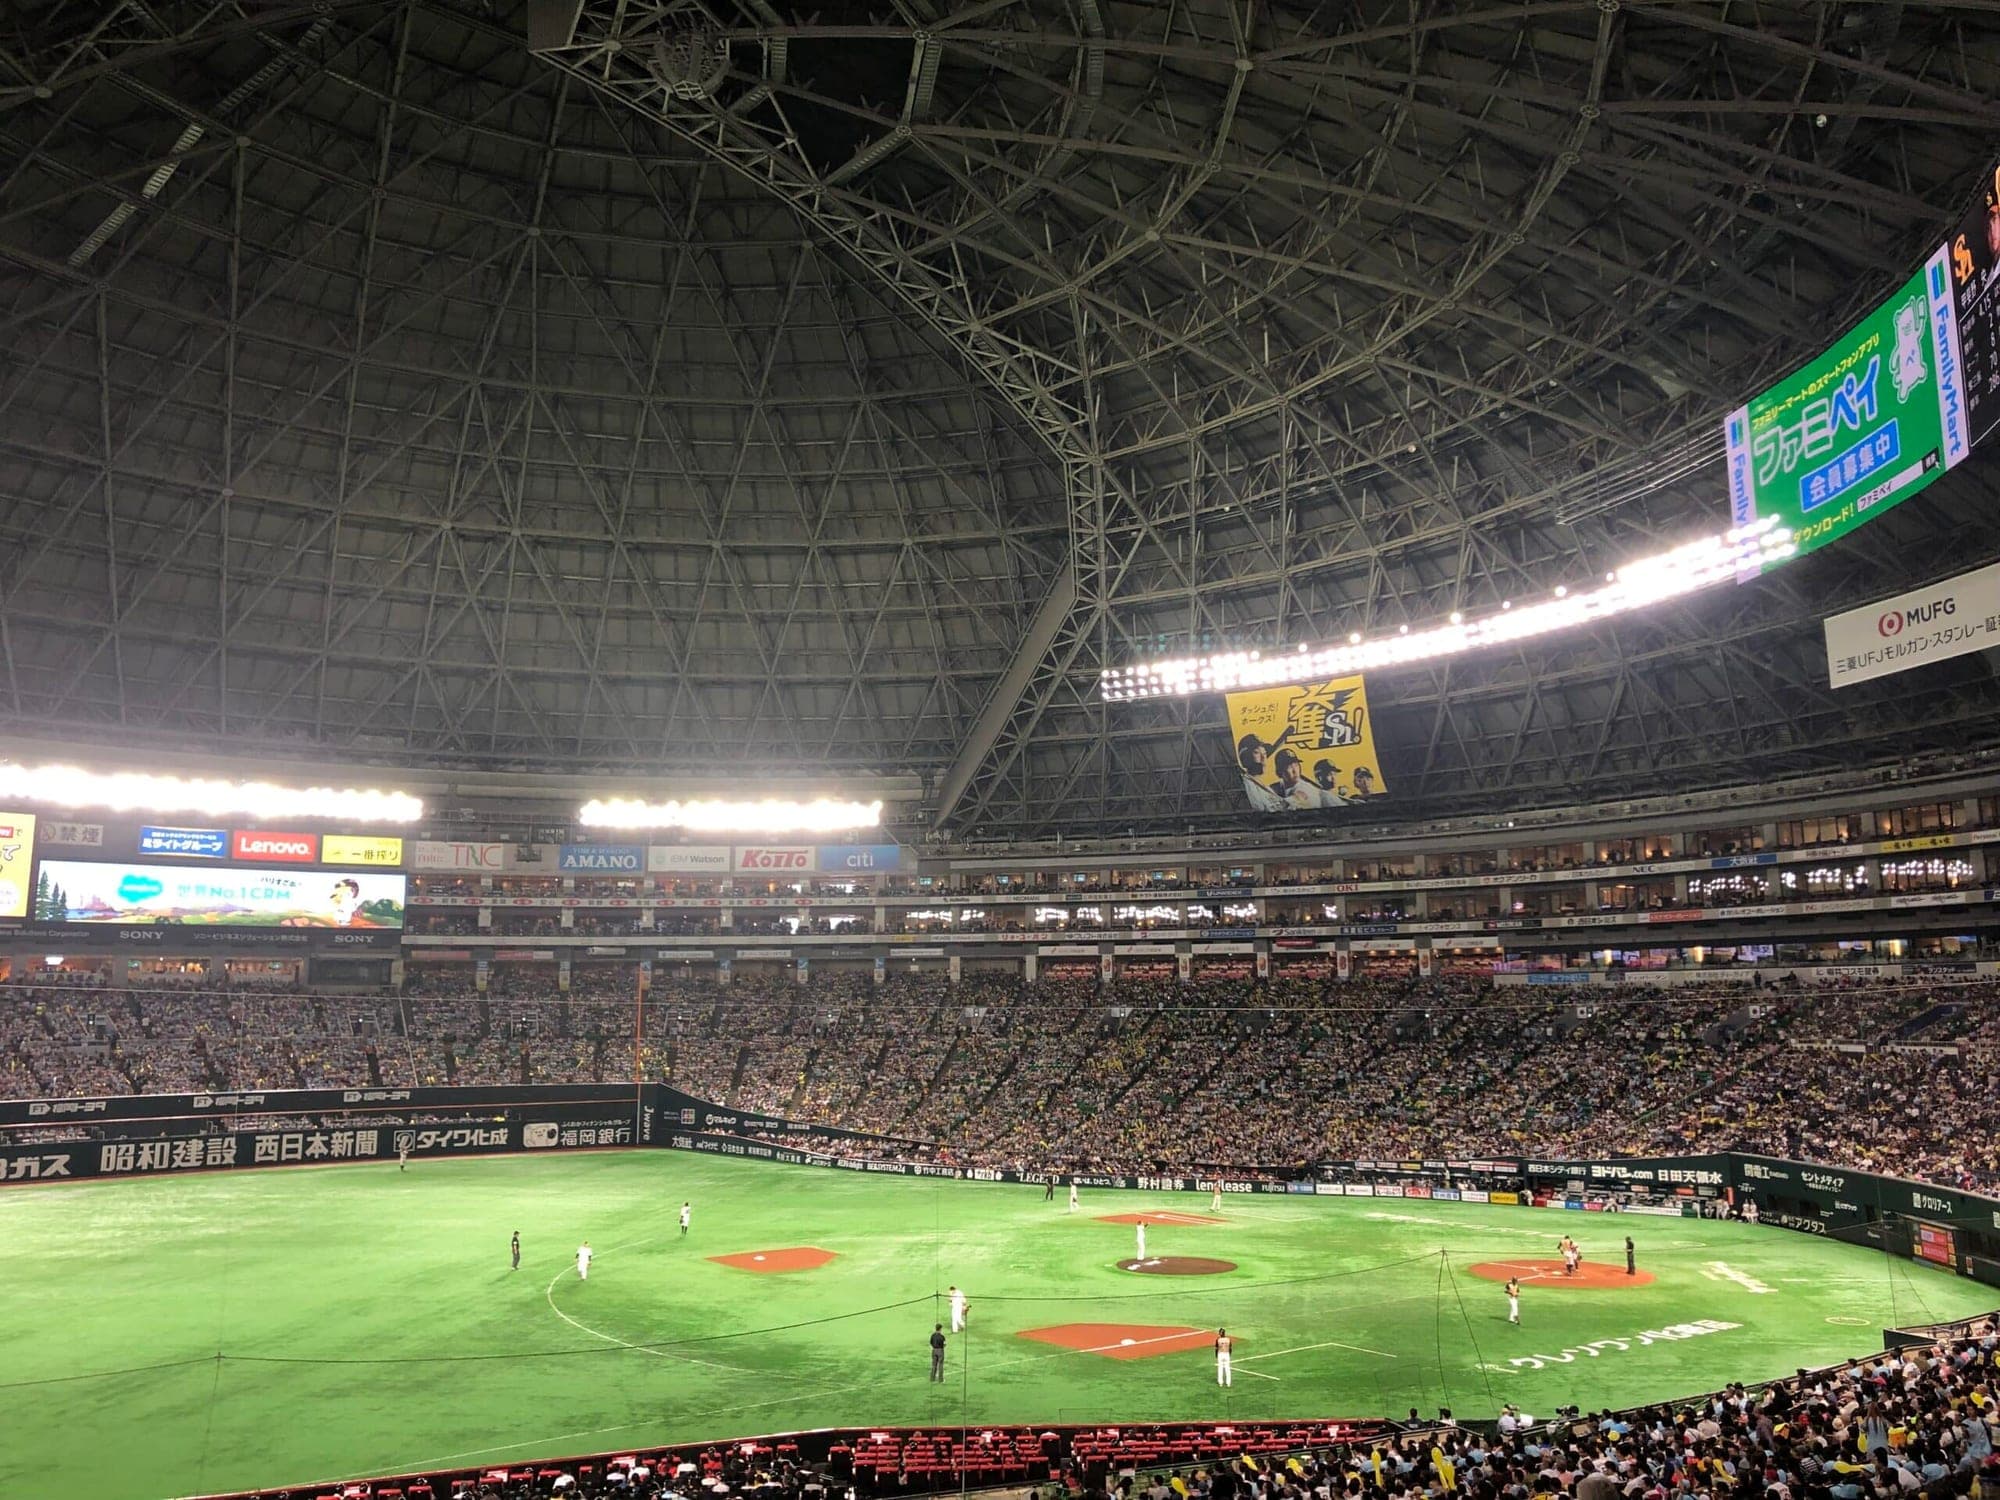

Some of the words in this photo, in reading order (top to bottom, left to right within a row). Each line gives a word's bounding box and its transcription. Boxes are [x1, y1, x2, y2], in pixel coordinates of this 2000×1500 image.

[1935, 301, 1963, 457] FamilyMart
[1754, 353, 1881, 486] ファミペイ
[1809, 434, 1897, 503] 会員募集中
[1860, 481, 1892, 509] ファミペイ
[1906, 598, 1956, 627] MUFG
[1241, 714, 1276, 726] ホークス!
[240, 837, 311, 856] Lenovo
[453, 845, 502, 867] TNC
[563, 855, 638, 868] AMANO
[690, 856, 726, 864] Watson
[846, 853, 874, 868] citi
[1632, 866, 1655, 874] NEC
[1337, 884, 1358, 893] OKI
[119, 930, 164, 940] SONY
[334, 935, 375, 944] SONY
[416, 1128, 509, 1150] ダイワ化成
[560, 1127, 632, 1147] 福岡銀行
[254, 1130, 378, 1162] 西日本新聞
[100, 1138, 237, 1172] 昭和建設
[1528, 1163, 1587, 1176] 西日本シティ銀行
[1591, 1165, 1653, 1180] ヨドバシ.com
[1658, 1169, 1723, 1184] 日田天領水
[1019, 1172, 1060, 1185] LEGED
[1137, 1176, 1185, 1191] 野村證券
[1261, 1183, 1286, 1193] FUJITSU
